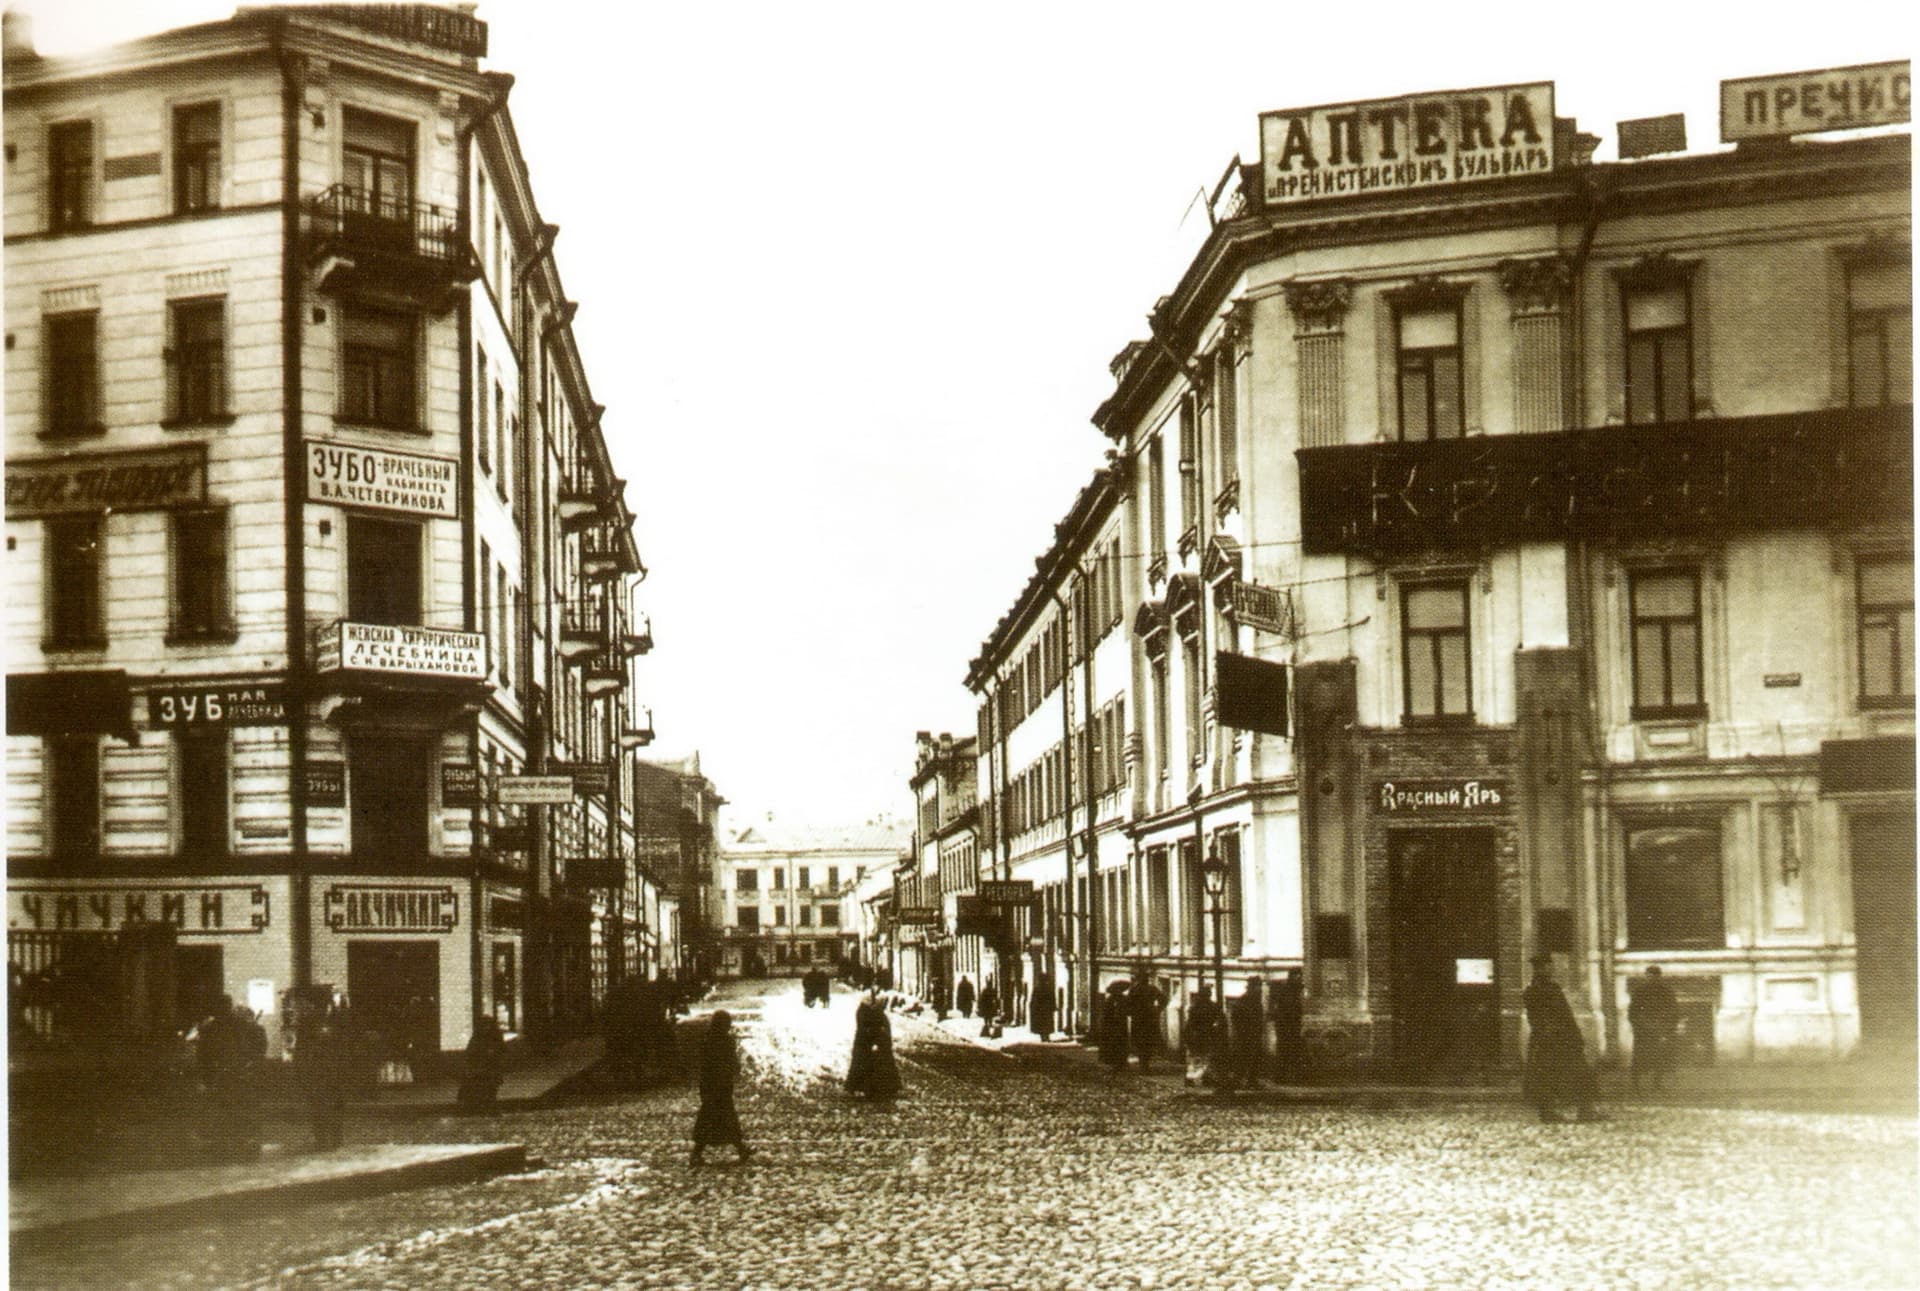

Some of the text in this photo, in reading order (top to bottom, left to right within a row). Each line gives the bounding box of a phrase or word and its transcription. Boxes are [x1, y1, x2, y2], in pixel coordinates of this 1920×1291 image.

[1277, 94, 1542, 172] АПТЕКА
[348, 626, 480, 650] ЖЕНСКАЯ ХИРУРГИЧЕСКАЯ
[355, 643, 476, 663] ЛЕЧЕБНИЦА
[160, 693, 223, 721] ЗУБ
